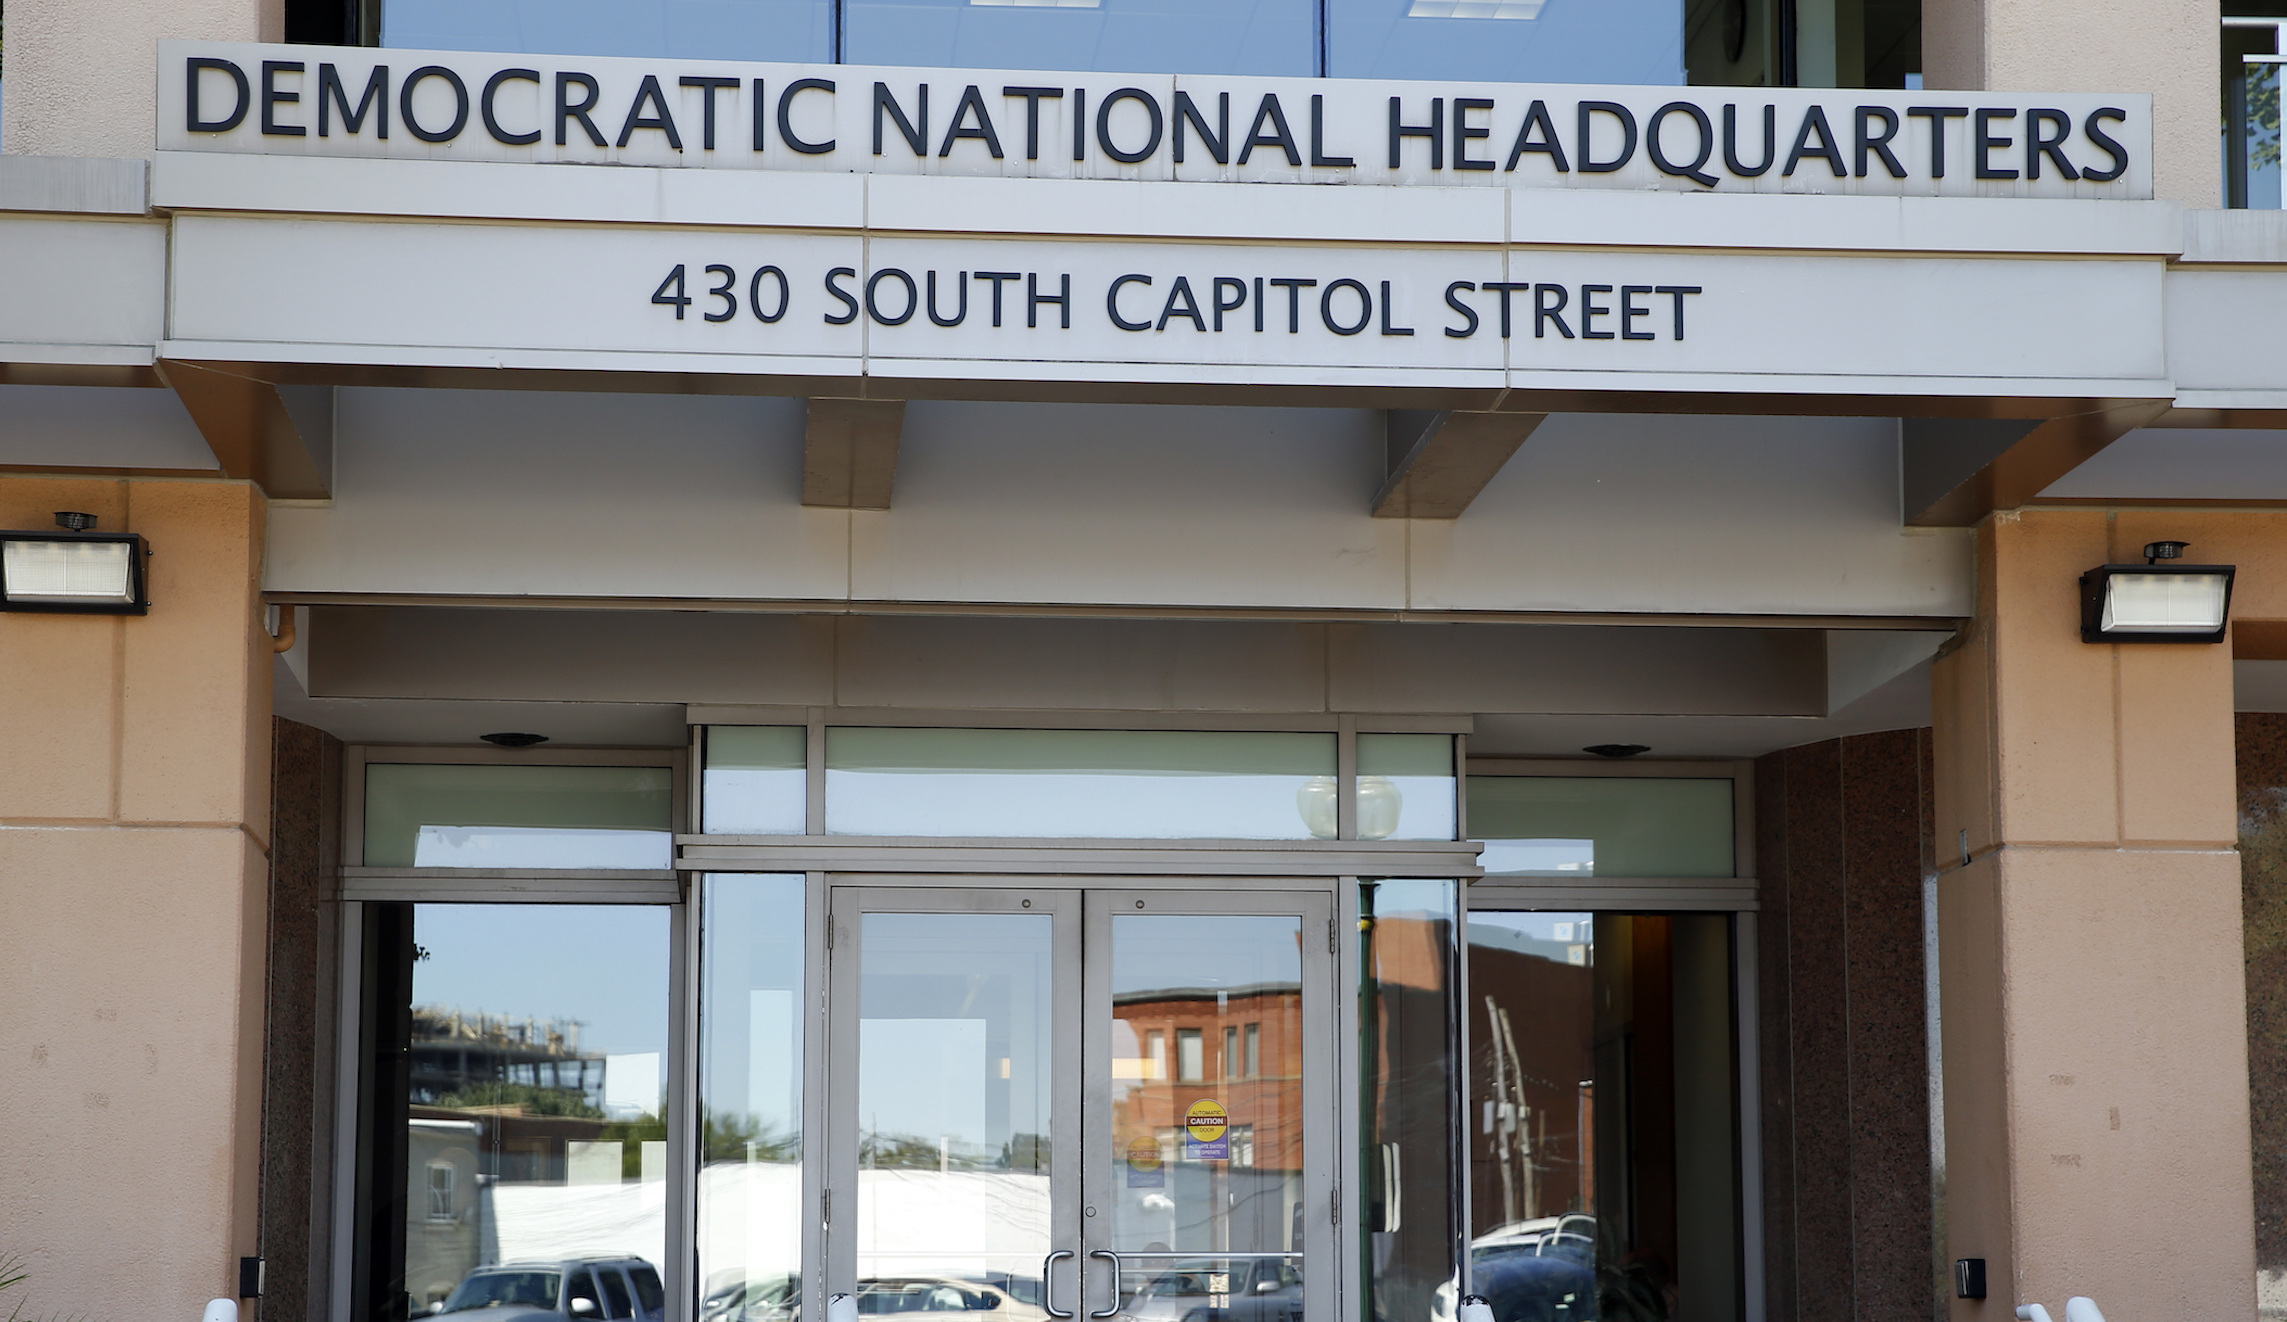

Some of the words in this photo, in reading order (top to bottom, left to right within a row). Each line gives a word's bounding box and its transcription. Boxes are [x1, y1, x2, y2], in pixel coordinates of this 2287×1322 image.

[186, 57, 836, 155] DEMOCRATIC
[872, 81, 1357, 170] NATIONAL
[1388, 96, 2129, 189] HEADQUARTERS
[651, 263, 790, 324] 430
[823, 266, 1071, 330] SOUTH
[1106, 273, 1415, 337] CAPITOL
[1444, 281, 1703, 341] STREET
[1190, 1117, 1224, 1125] CAUTION
